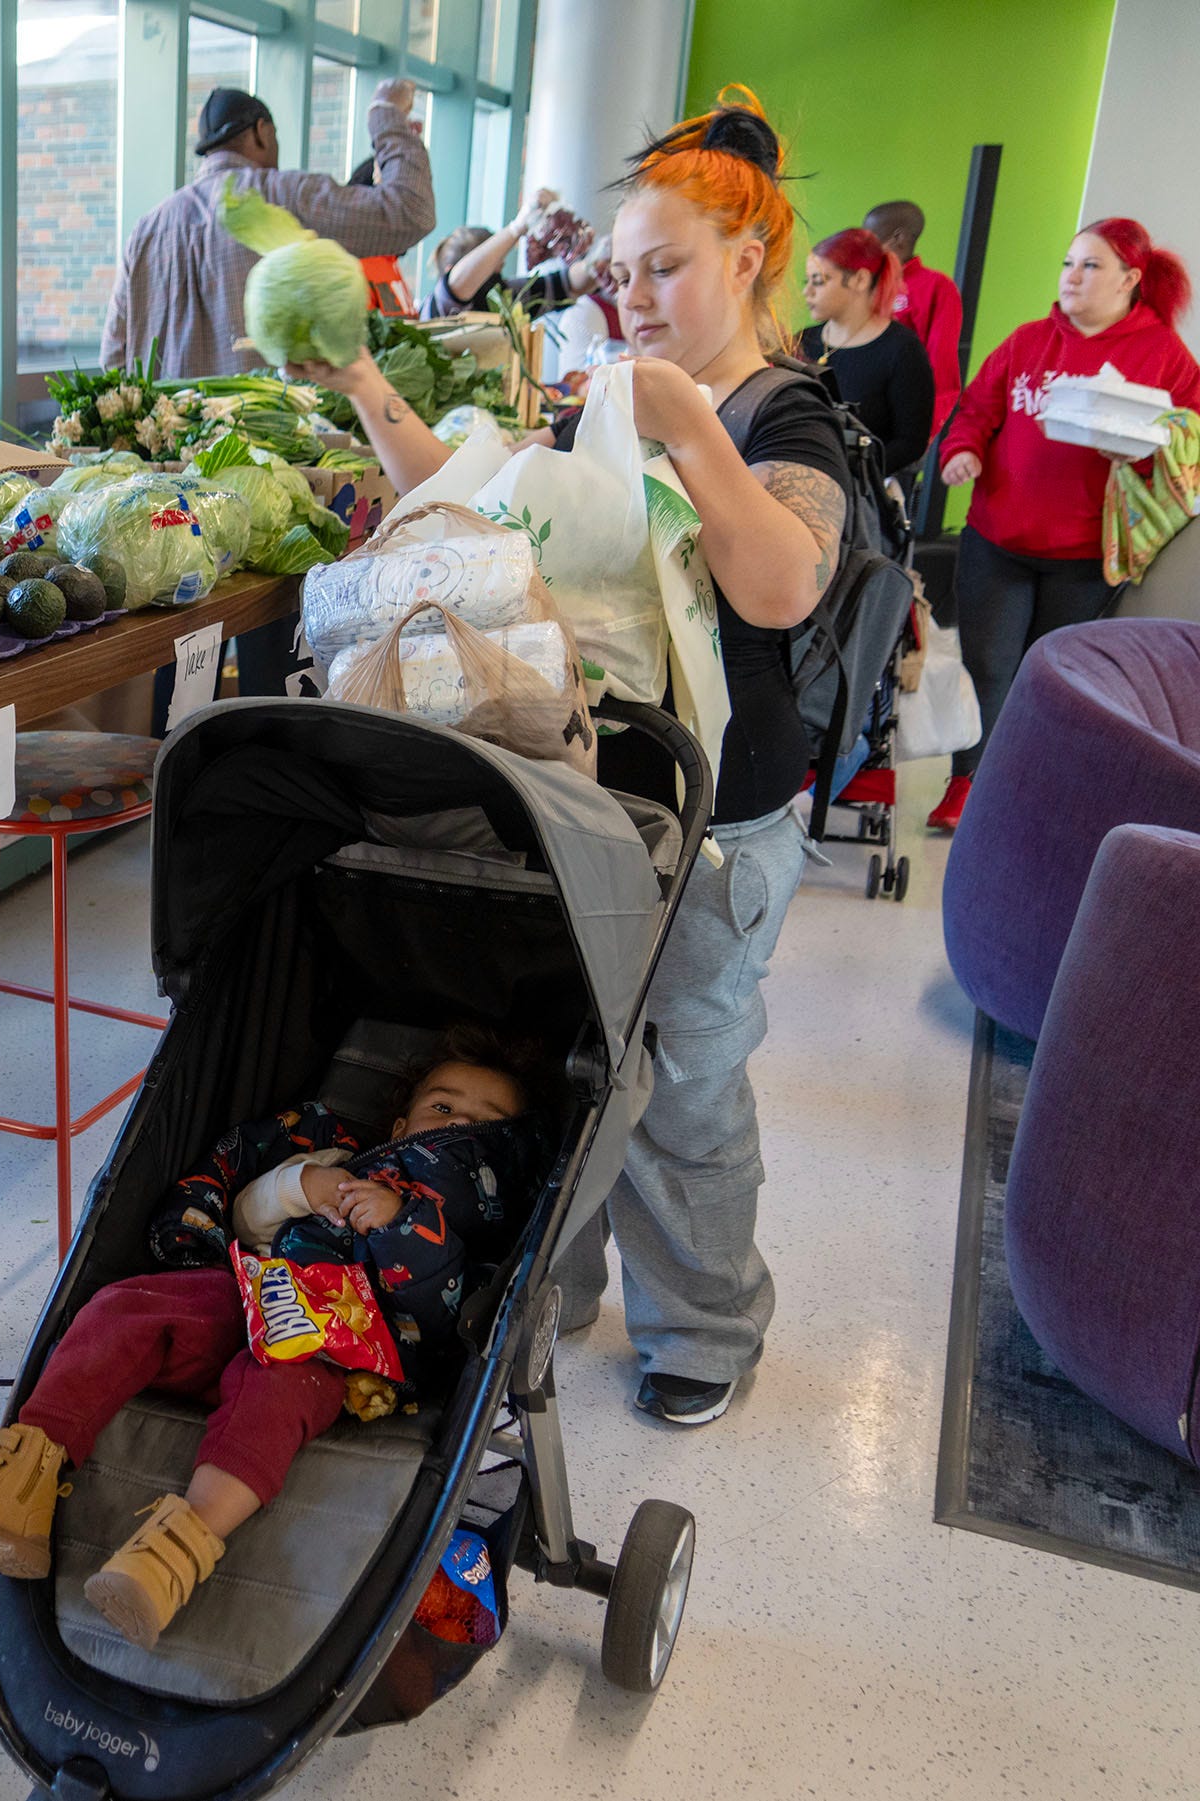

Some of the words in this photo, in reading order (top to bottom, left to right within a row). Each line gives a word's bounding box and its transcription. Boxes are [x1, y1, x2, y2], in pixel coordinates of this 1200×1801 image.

[180, 633, 207, 682] Take
[44, 1701, 85, 1736] baby
[81, 1721, 140, 1758] jogger
